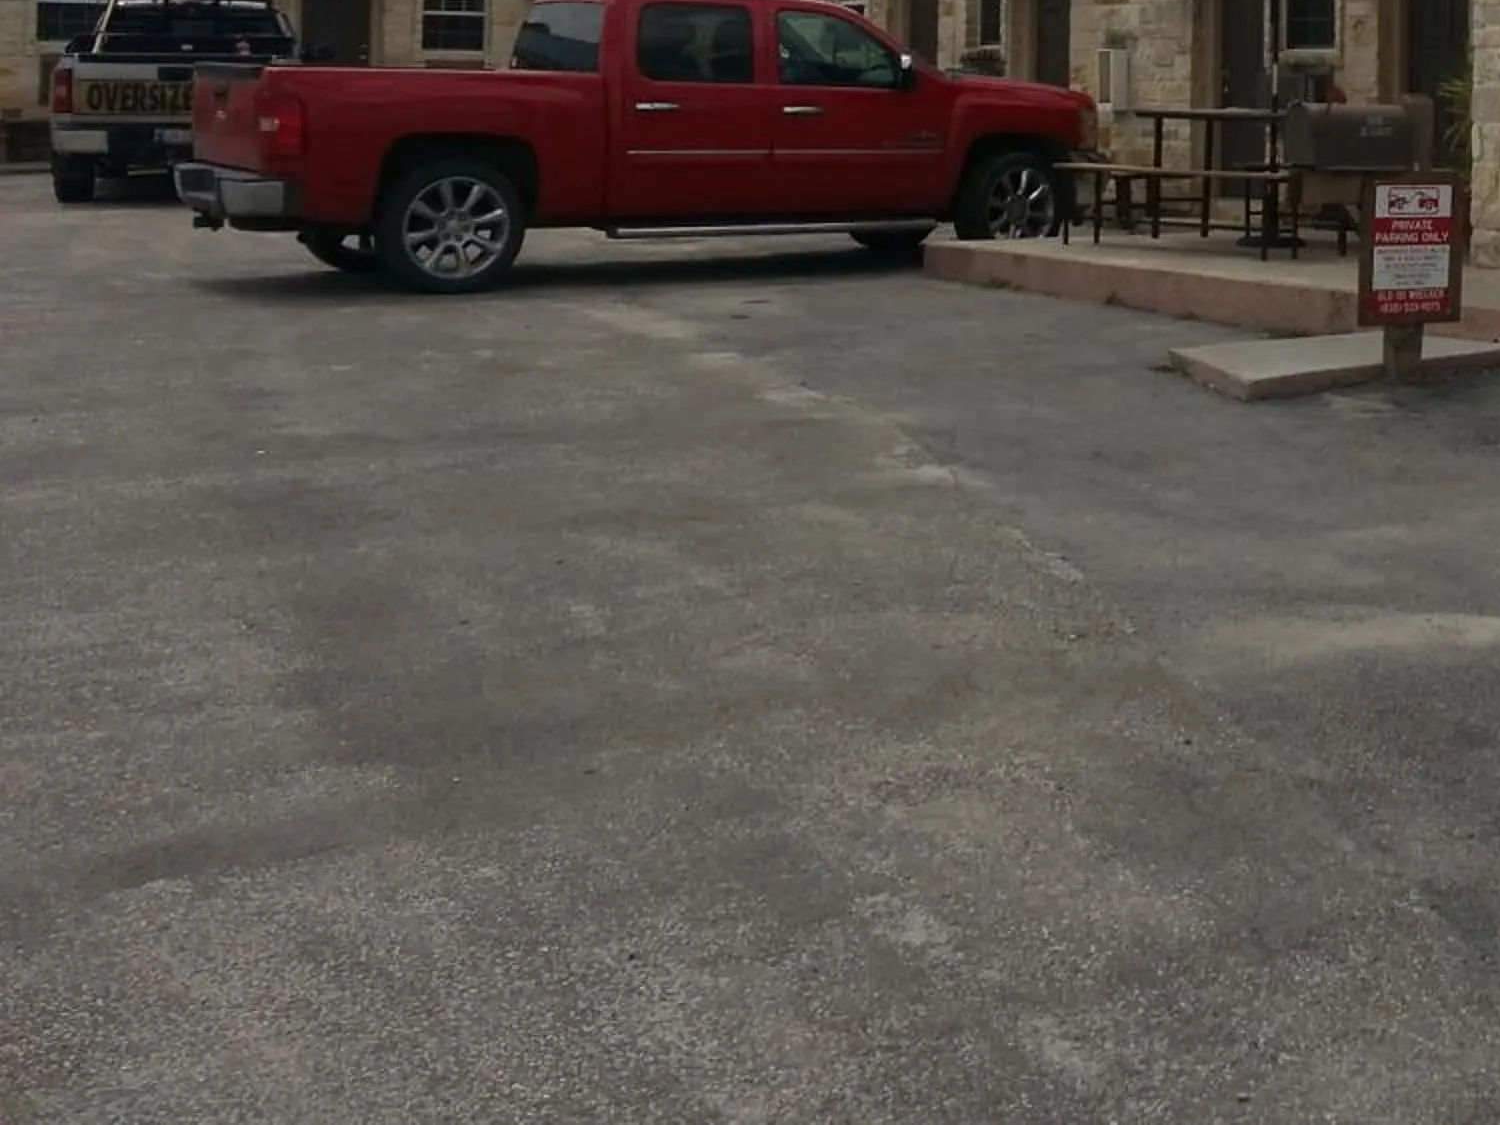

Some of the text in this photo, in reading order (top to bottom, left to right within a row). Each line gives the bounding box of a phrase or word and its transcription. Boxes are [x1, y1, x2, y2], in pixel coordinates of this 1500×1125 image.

[1391, 219, 1434, 231] PRIVATE
[1375, 230, 1450, 244] PARKING ONLY
